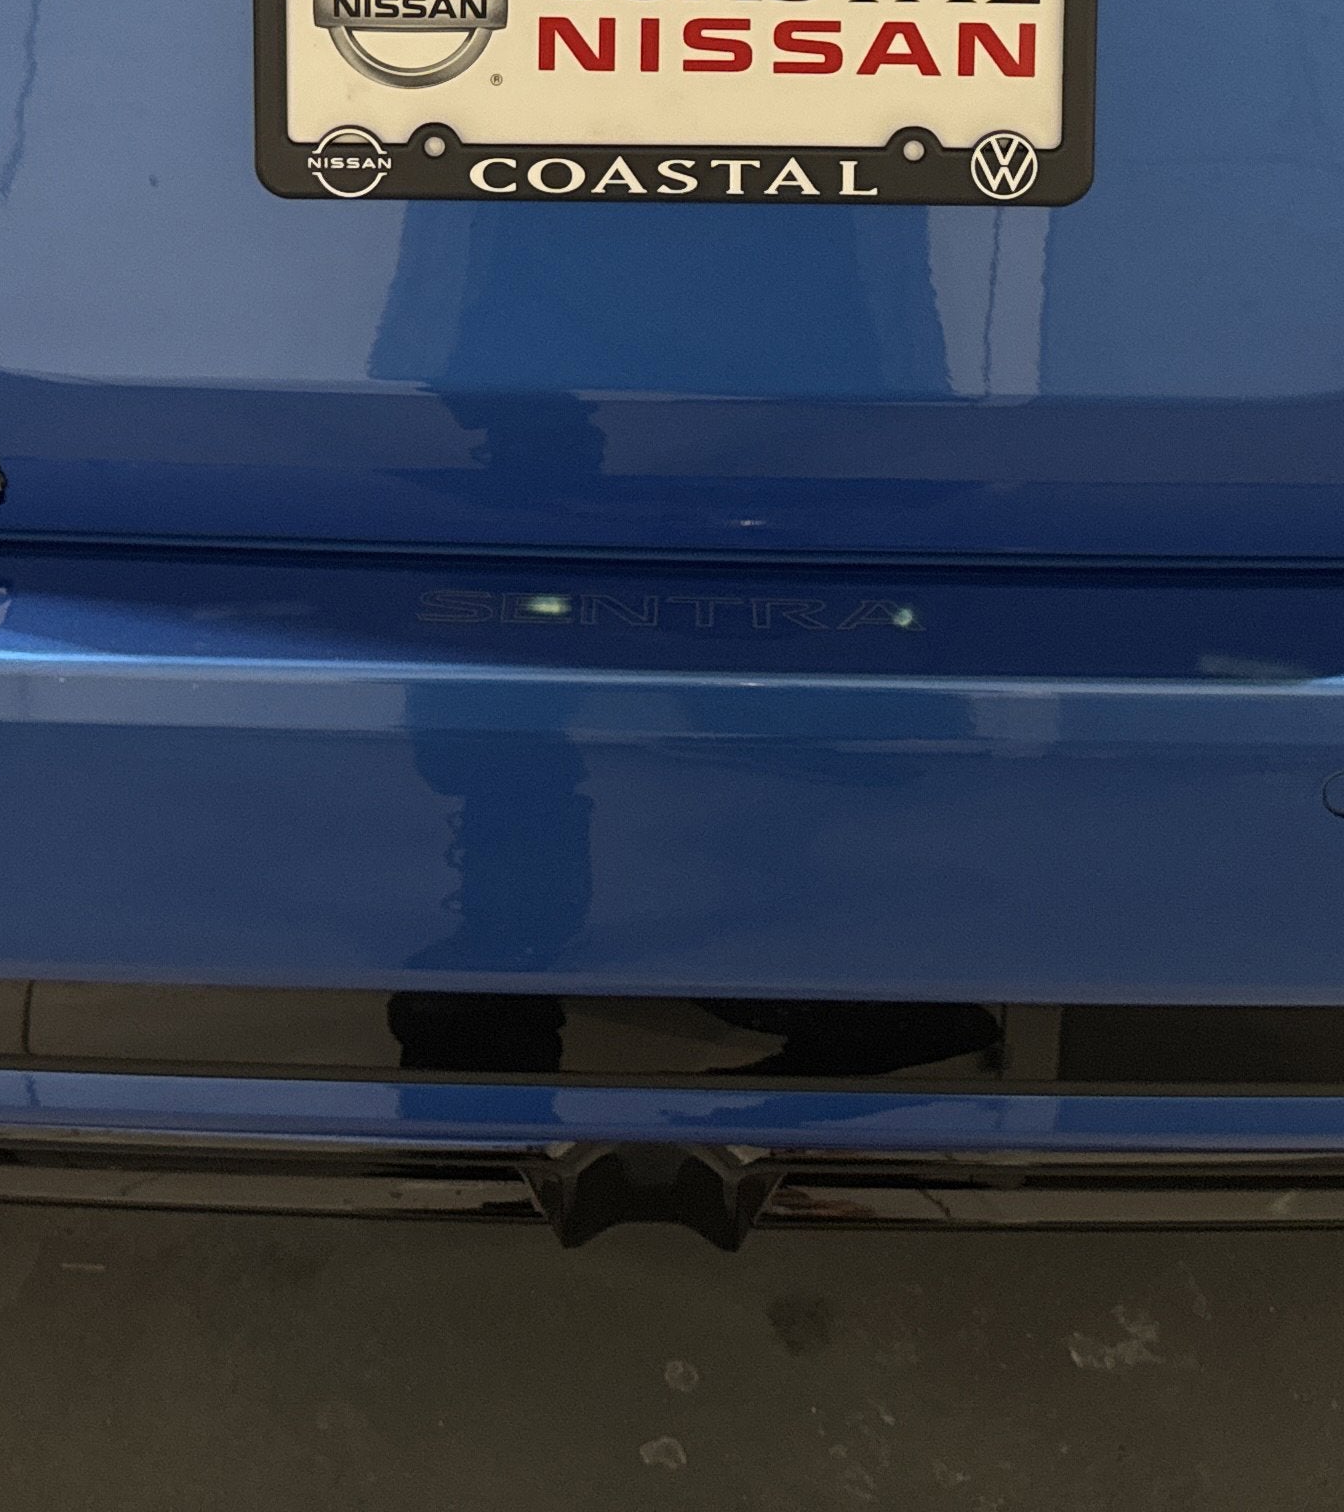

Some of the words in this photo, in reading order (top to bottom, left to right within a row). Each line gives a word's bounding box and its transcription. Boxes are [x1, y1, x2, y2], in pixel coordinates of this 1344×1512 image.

[538, 16, 1037, 77] NISSAN
[307, 157, 392, 170] NISSAN
[468, 155, 879, 196] COASTAL
